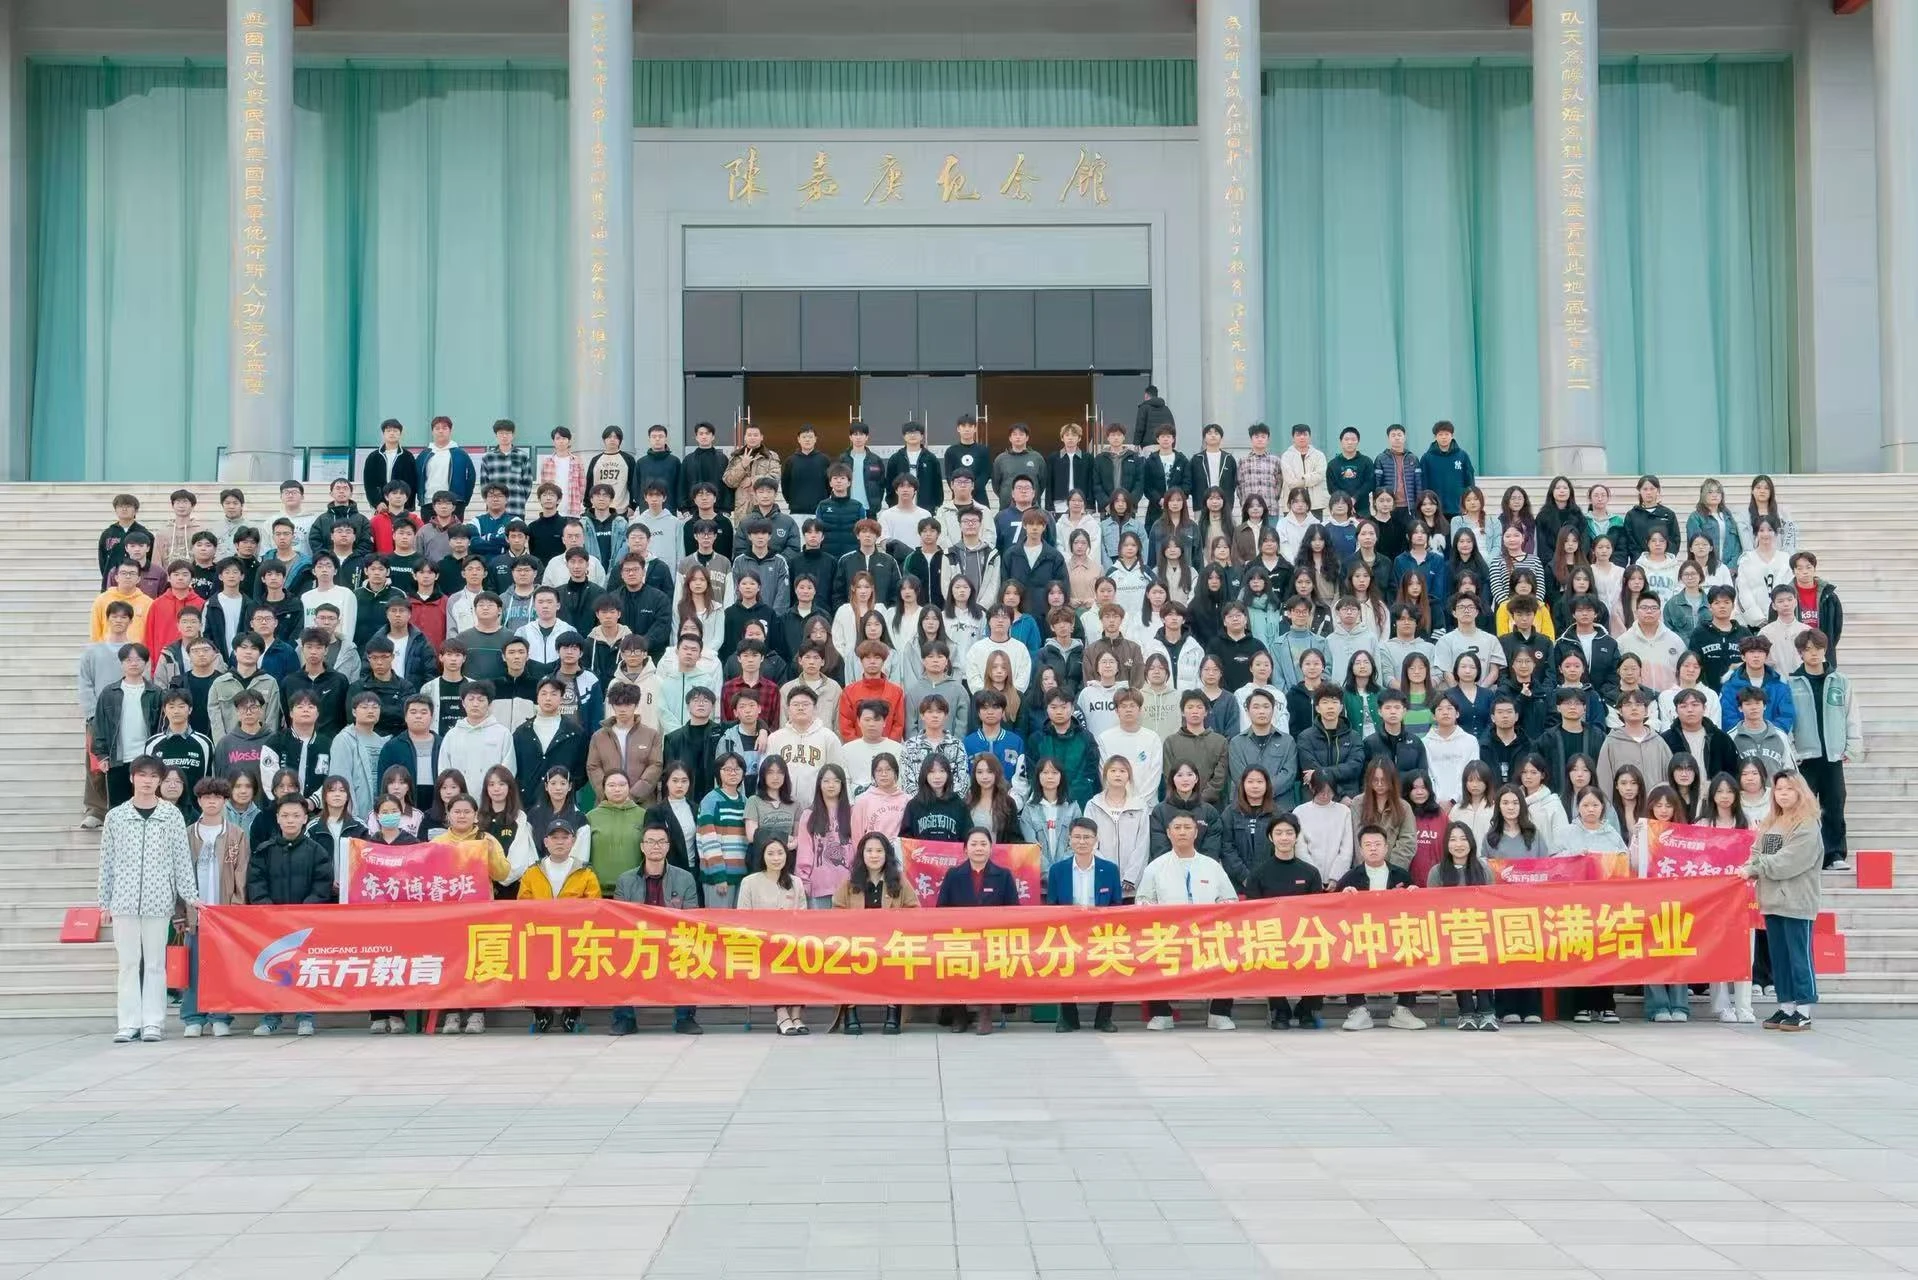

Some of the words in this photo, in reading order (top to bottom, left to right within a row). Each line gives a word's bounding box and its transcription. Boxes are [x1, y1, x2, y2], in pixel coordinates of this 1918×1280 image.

[599, 469, 620, 481] 1957
[779, 742, 822, 767] GAP
[361, 872, 477, 902] 东方博睿班
[307, 946, 358, 955] DONGFANG
[360, 945, 393, 954] JIAOYU
[464, 901, 1697, 985] 厦门东方教育2025年高职分类考试提分冲刺营圆满结业
[295, 955, 445, 988] 东方教育
